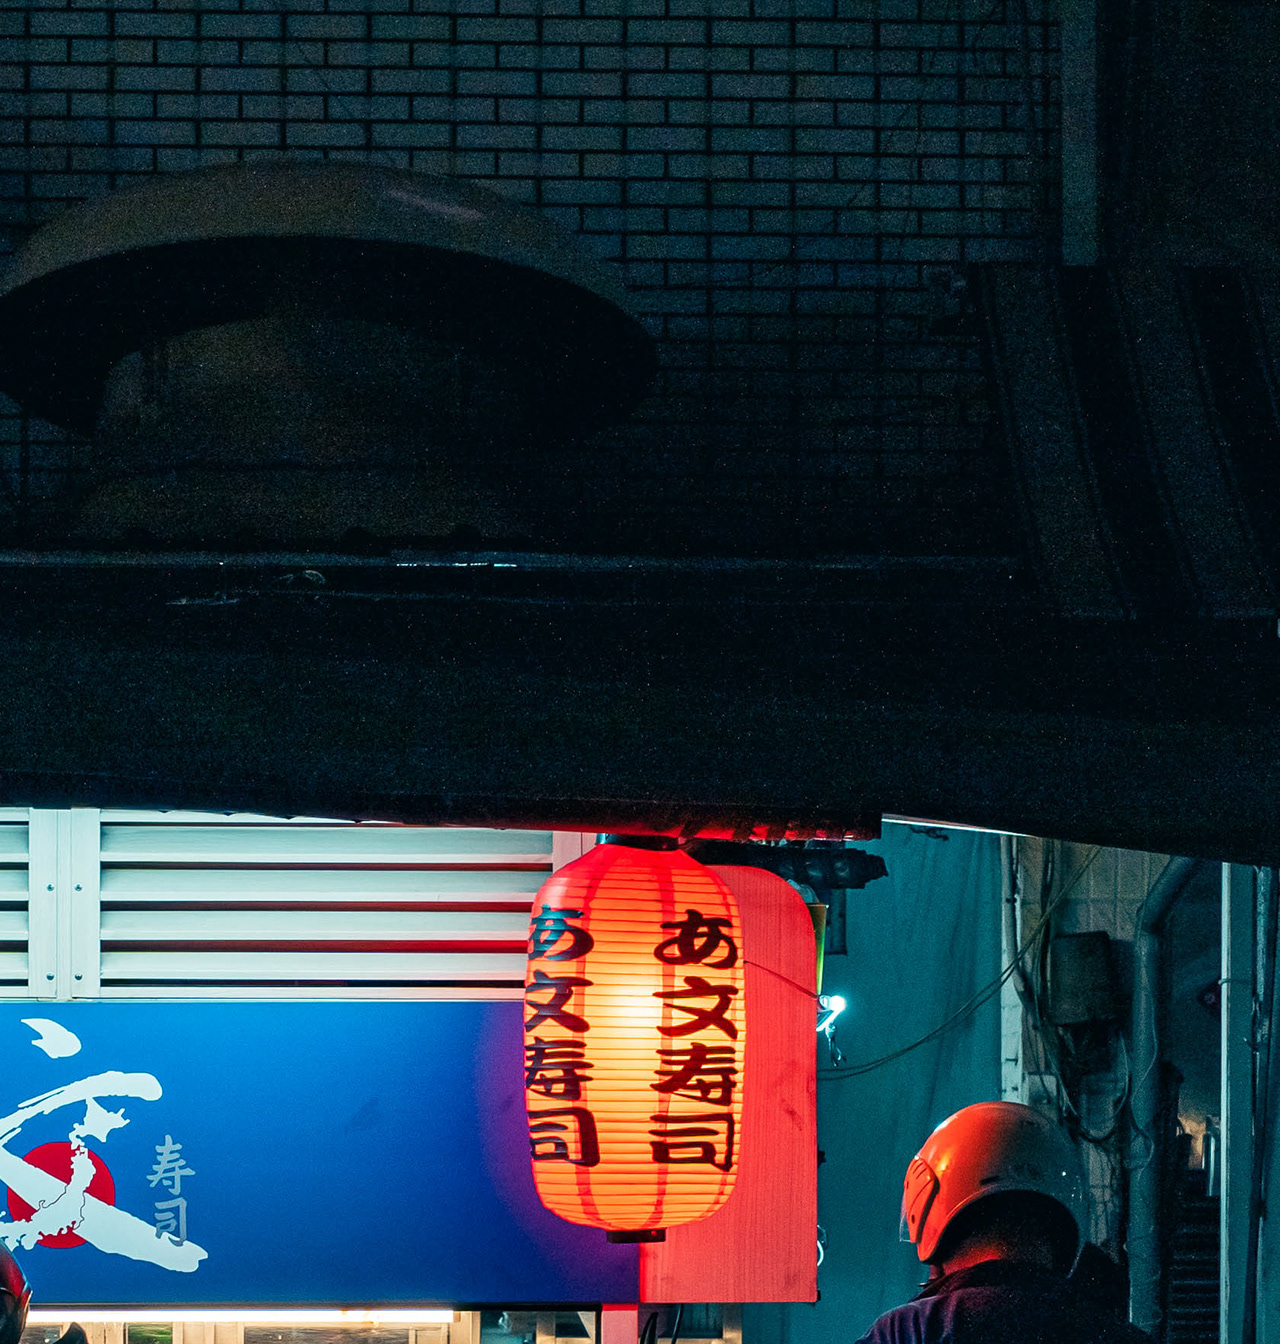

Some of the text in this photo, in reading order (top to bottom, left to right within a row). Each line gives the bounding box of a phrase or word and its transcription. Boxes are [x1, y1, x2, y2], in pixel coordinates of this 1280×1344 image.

[524, 903, 601, 1168] あ文寿司
[649, 909, 740, 1172] あ文寿司
[146, 1135, 196, 1247] 寿司
